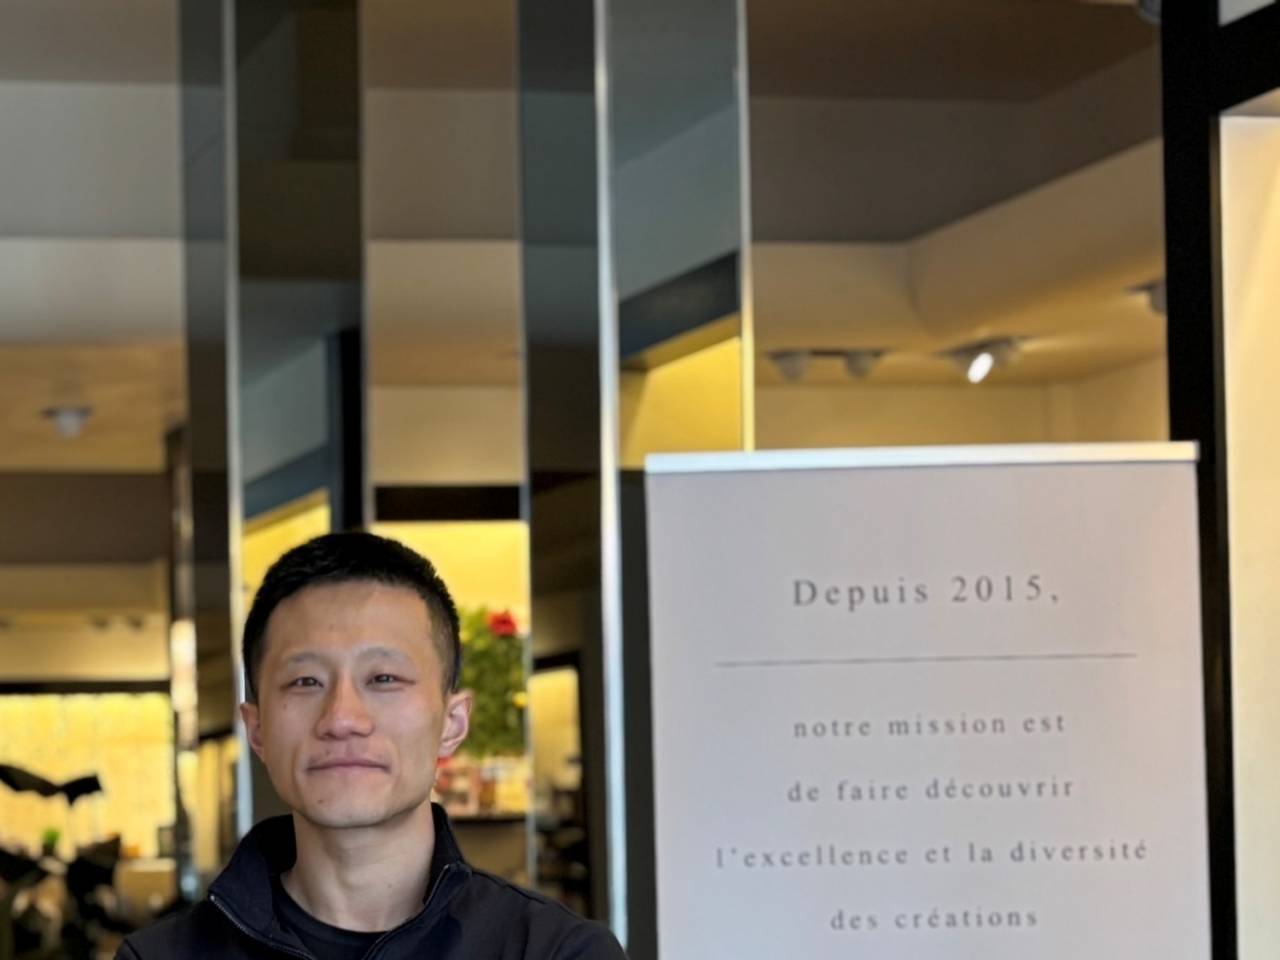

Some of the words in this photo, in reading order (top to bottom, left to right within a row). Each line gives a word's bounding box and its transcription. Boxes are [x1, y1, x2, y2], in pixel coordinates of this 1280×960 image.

[793, 577, 929, 612] Depuis
[951, 574, 1060, 604] 2015,
[793, 719, 872, 738] notre
[887, 714, 1006, 737] mission
[1023, 714, 1065, 734] est
[787, 780, 820, 802] de
[837, 780, 908, 801] faire
[925, 776, 1074, 800] découvrir
[716, 844, 908, 869] l'excellence
[925, 845, 951, 865] et
[968, 841, 993, 863] la
[1009, 839, 1148, 863] diversité
[829, 908, 878, 931] des
[894, 907, 1038, 930] créations
